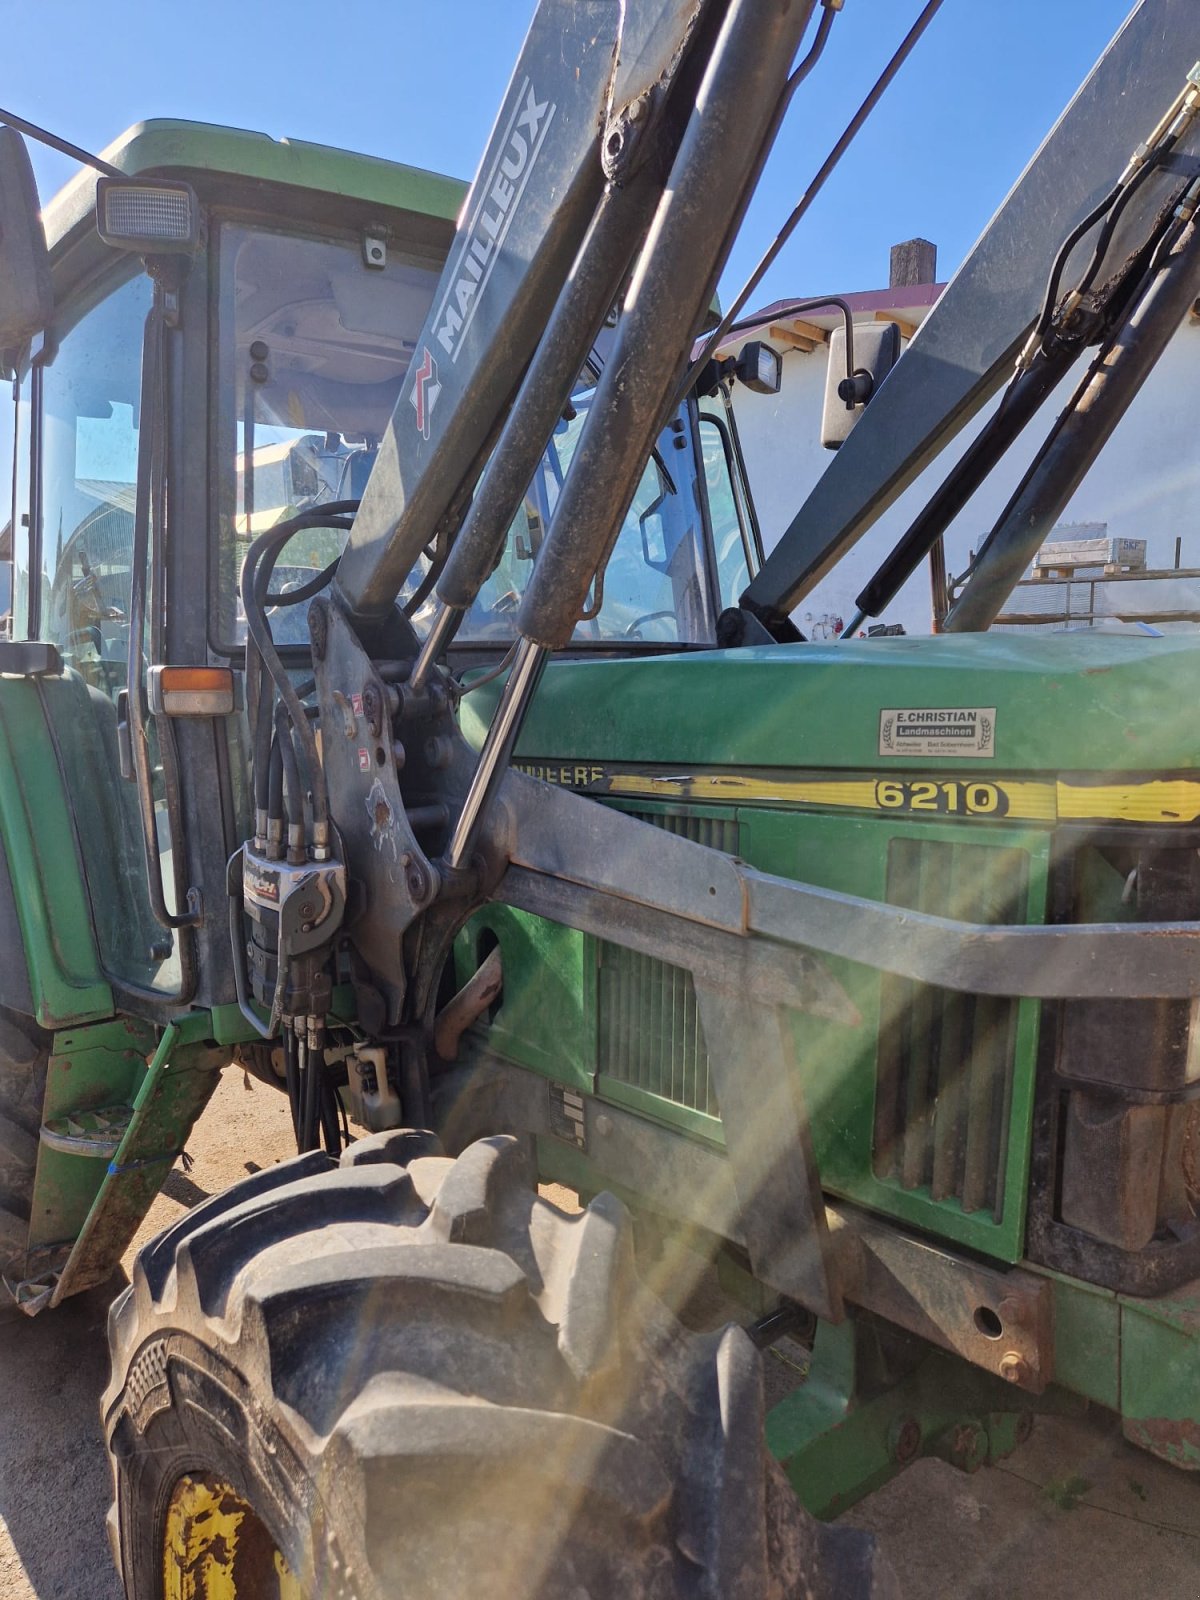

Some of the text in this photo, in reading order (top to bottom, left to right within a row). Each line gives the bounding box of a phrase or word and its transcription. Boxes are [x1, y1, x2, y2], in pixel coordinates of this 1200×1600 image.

[437, 84, 549, 355] MAILLEUX
[899, 727, 972, 736] Landmaschinen
[877, 781, 998, 813] 6210
